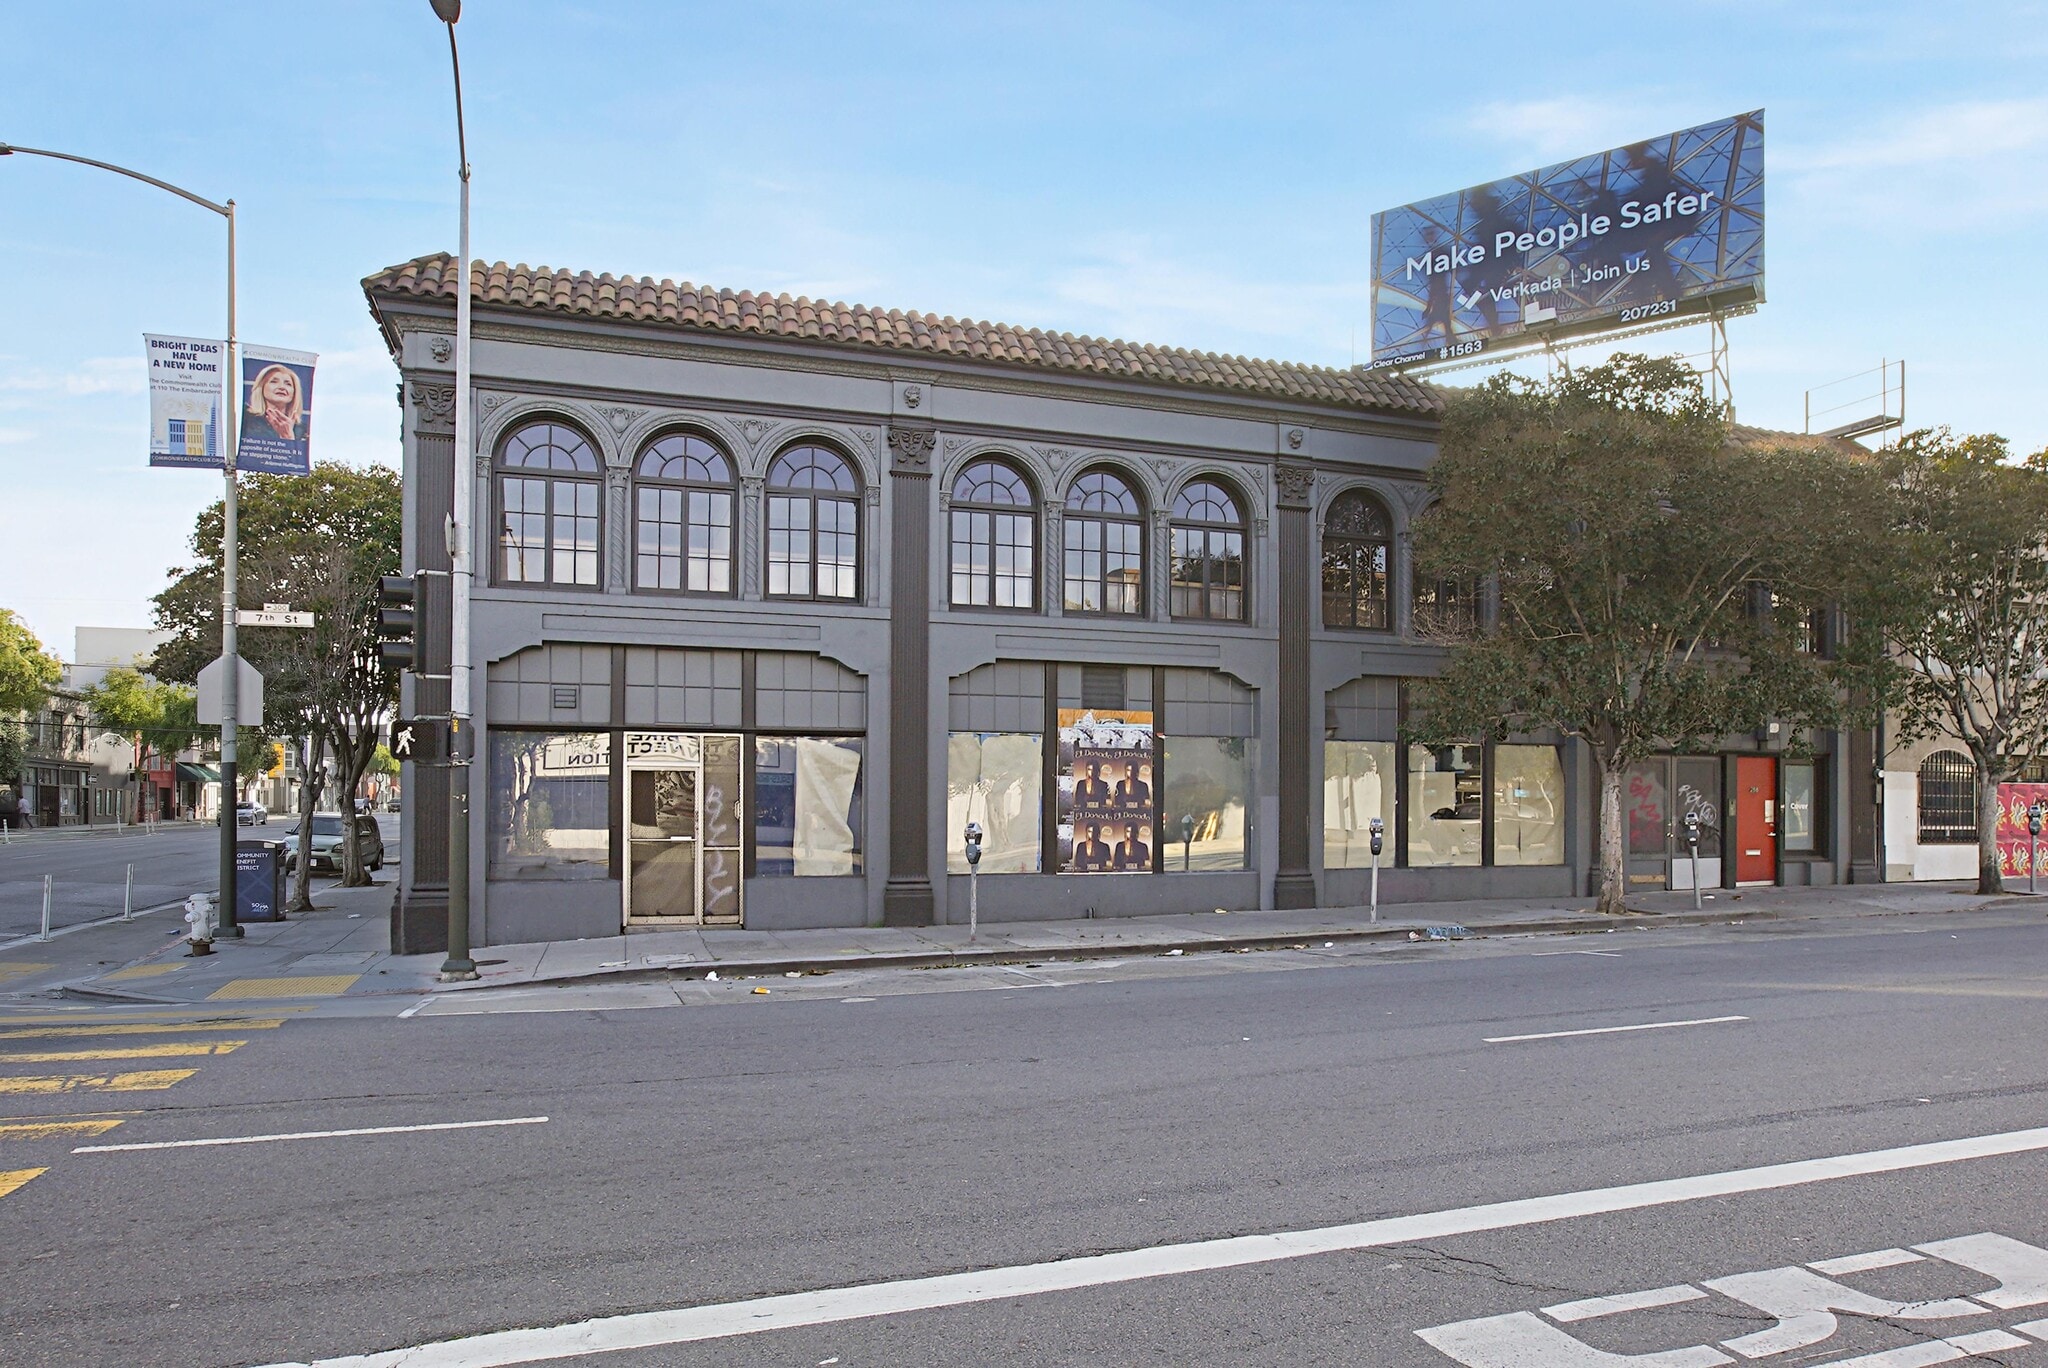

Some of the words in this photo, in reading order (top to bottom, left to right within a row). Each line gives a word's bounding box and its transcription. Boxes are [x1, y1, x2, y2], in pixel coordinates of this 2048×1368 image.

[1406, 245, 1485, 281] Make
[1495, 213, 1610, 258] People
[1620, 190, 1714, 229] Safer
[1490, 276, 1562, 303] Verkada
[1581, 264, 1620, 285] Join
[1625, 256, 1651, 274] Us
[1620, 300, 1676, 322] 207231
[151, 339, 187, 351] BRIGHT
[190, 343, 218, 354] IDEAS
[1439, 340, 1483, 360] #1563
[172, 351, 198, 361] HAVE
[249, 350, 300, 362] COMMONWEALTH
[1373, 358, 1394, 369] Clear
[1394, 352, 1426, 365] Channel
[153, 359, 160, 367] A
[163, 360, 185, 370] NEW
[189, 362, 217, 372] HOME
[161, 379, 207, 388] Commonwealth
[256, 614, 275, 622] 7th
[284, 615, 298, 623] St
[1790, 802, 1808, 810] Cover
